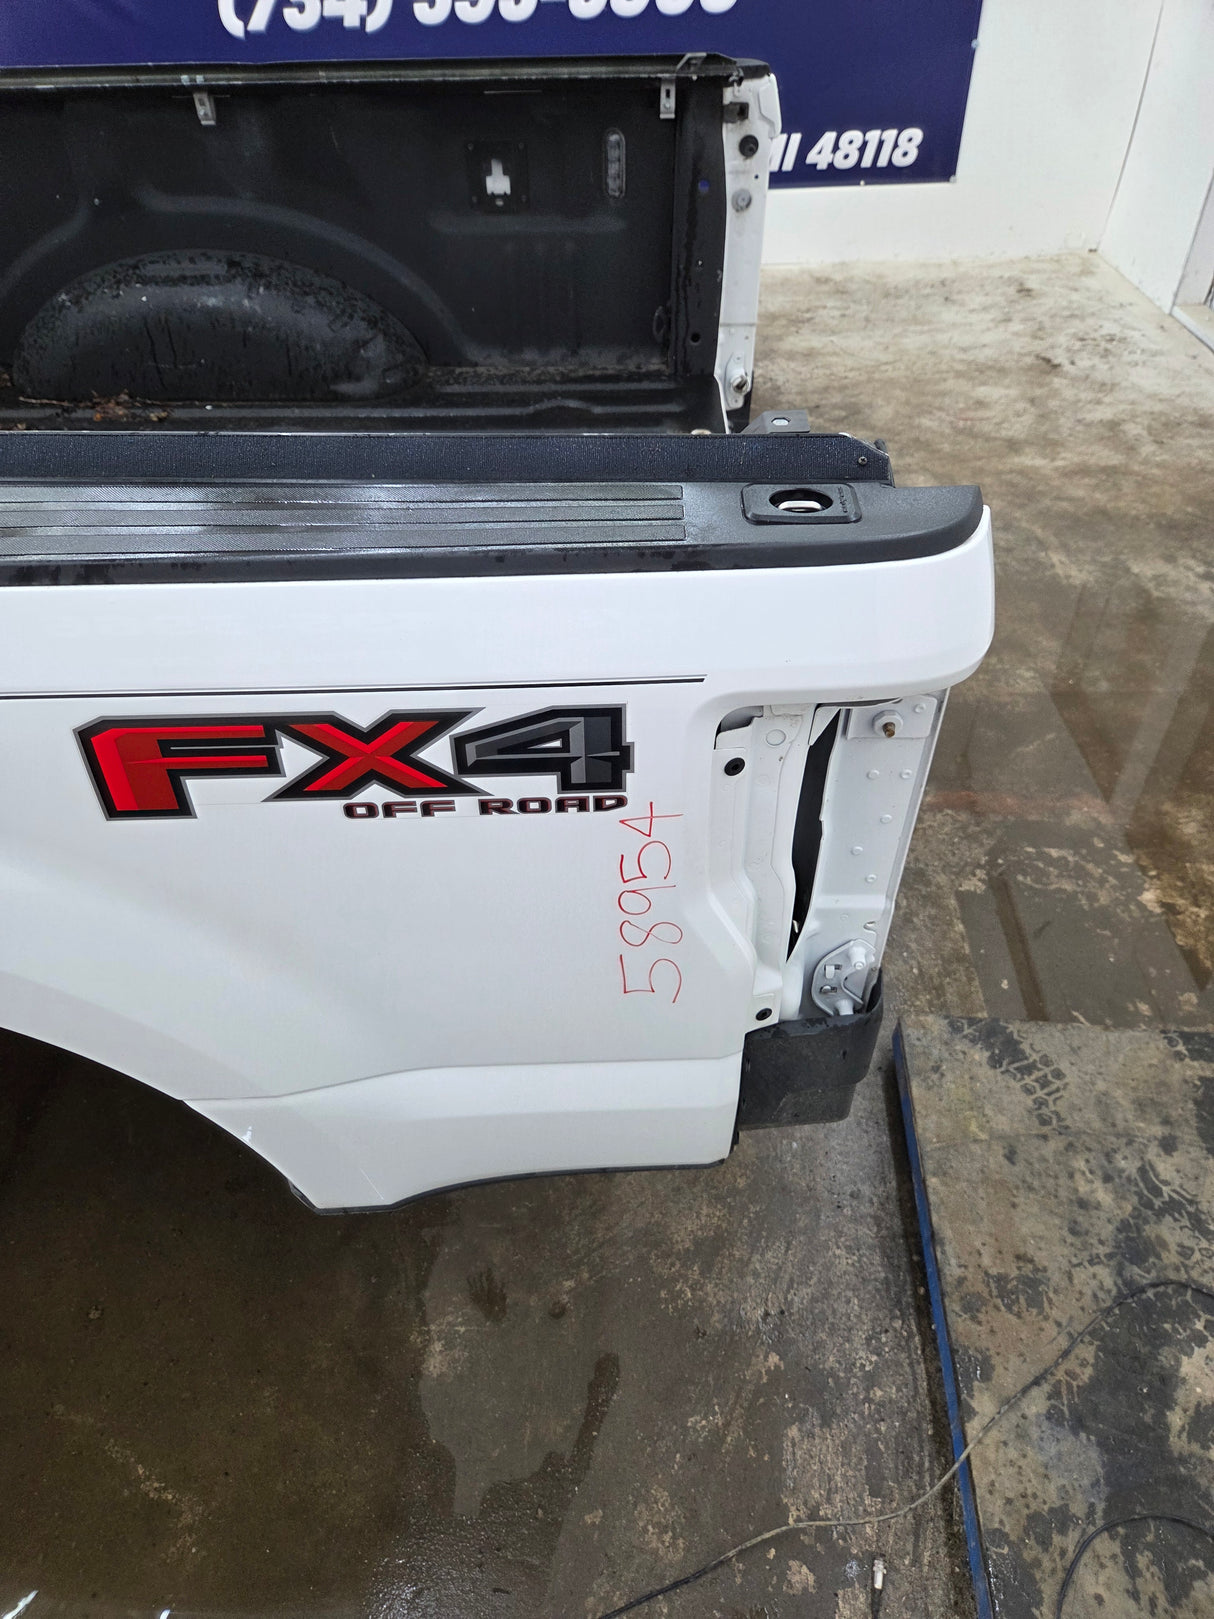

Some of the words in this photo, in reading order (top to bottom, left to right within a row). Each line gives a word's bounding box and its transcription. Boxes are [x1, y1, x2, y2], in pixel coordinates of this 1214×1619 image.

[805, 127, 924, 170] 48118
[73, 703, 635, 821] FX4
[343, 800, 456, 819] OFF
[478, 795, 628, 816] ROAD
[618, 801, 684, 1004] 58954
